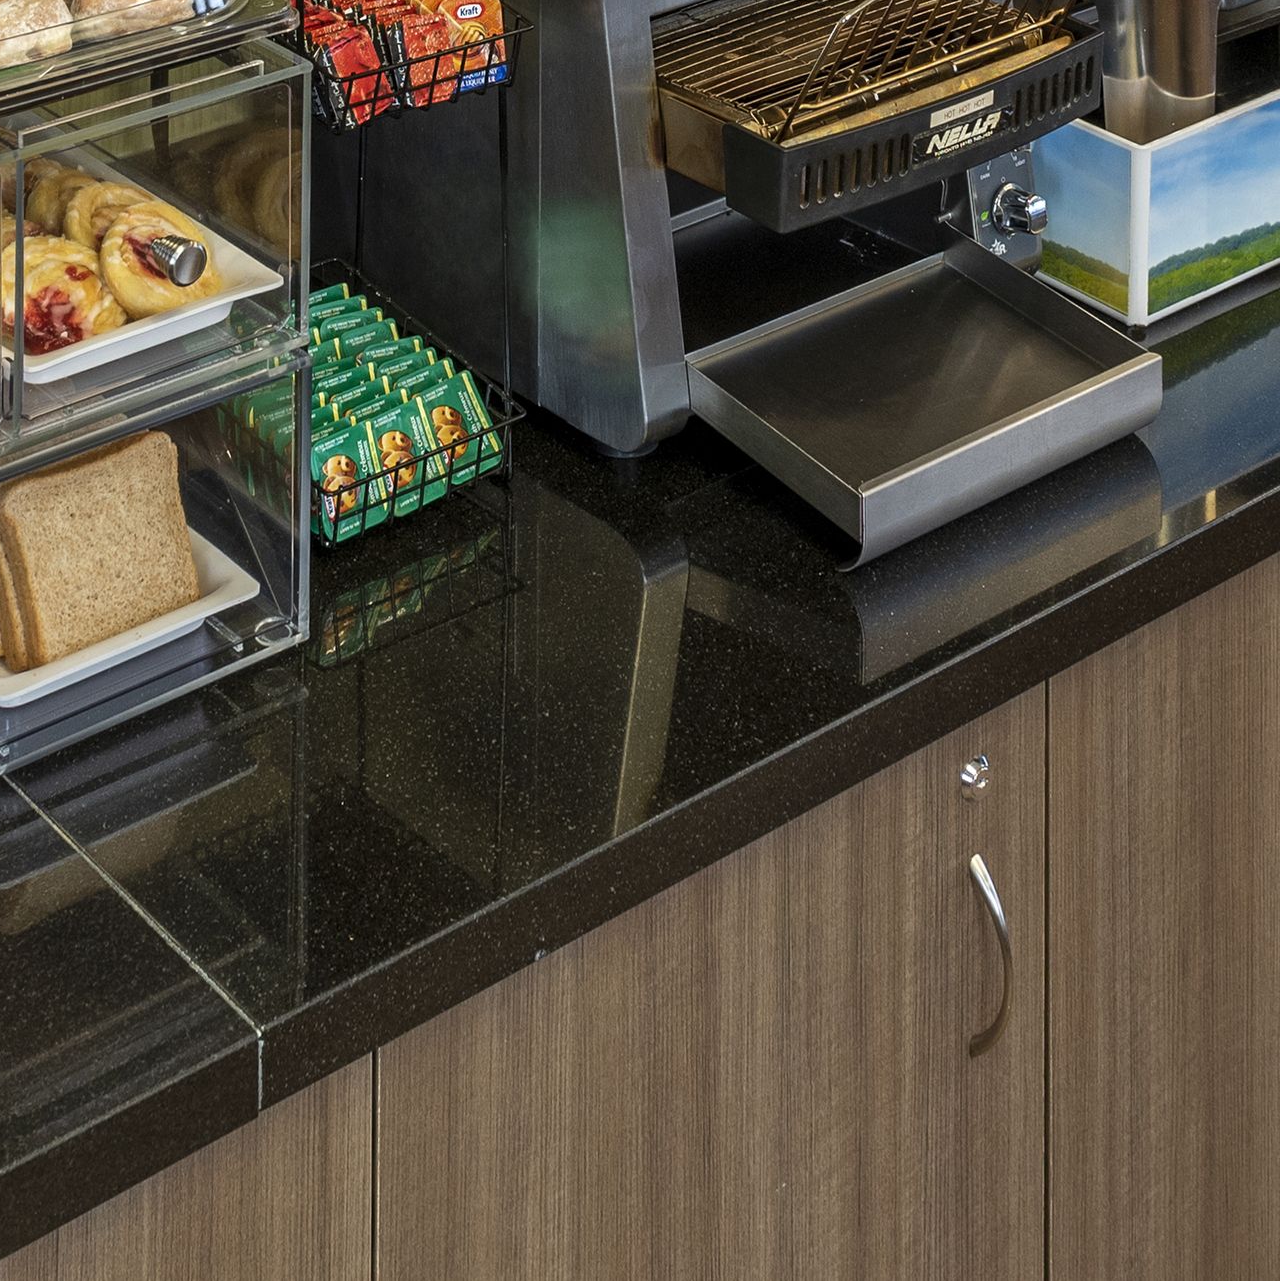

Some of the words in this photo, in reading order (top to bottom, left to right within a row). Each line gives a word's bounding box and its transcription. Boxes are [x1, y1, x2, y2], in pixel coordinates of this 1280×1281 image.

[460, 5, 479, 17] Kraft
[943, 109, 955, 120] HOT
[958, 103, 971, 114] HOT
[973, 98, 985, 109] HOT
[926, 111, 1001, 154] NELLA
